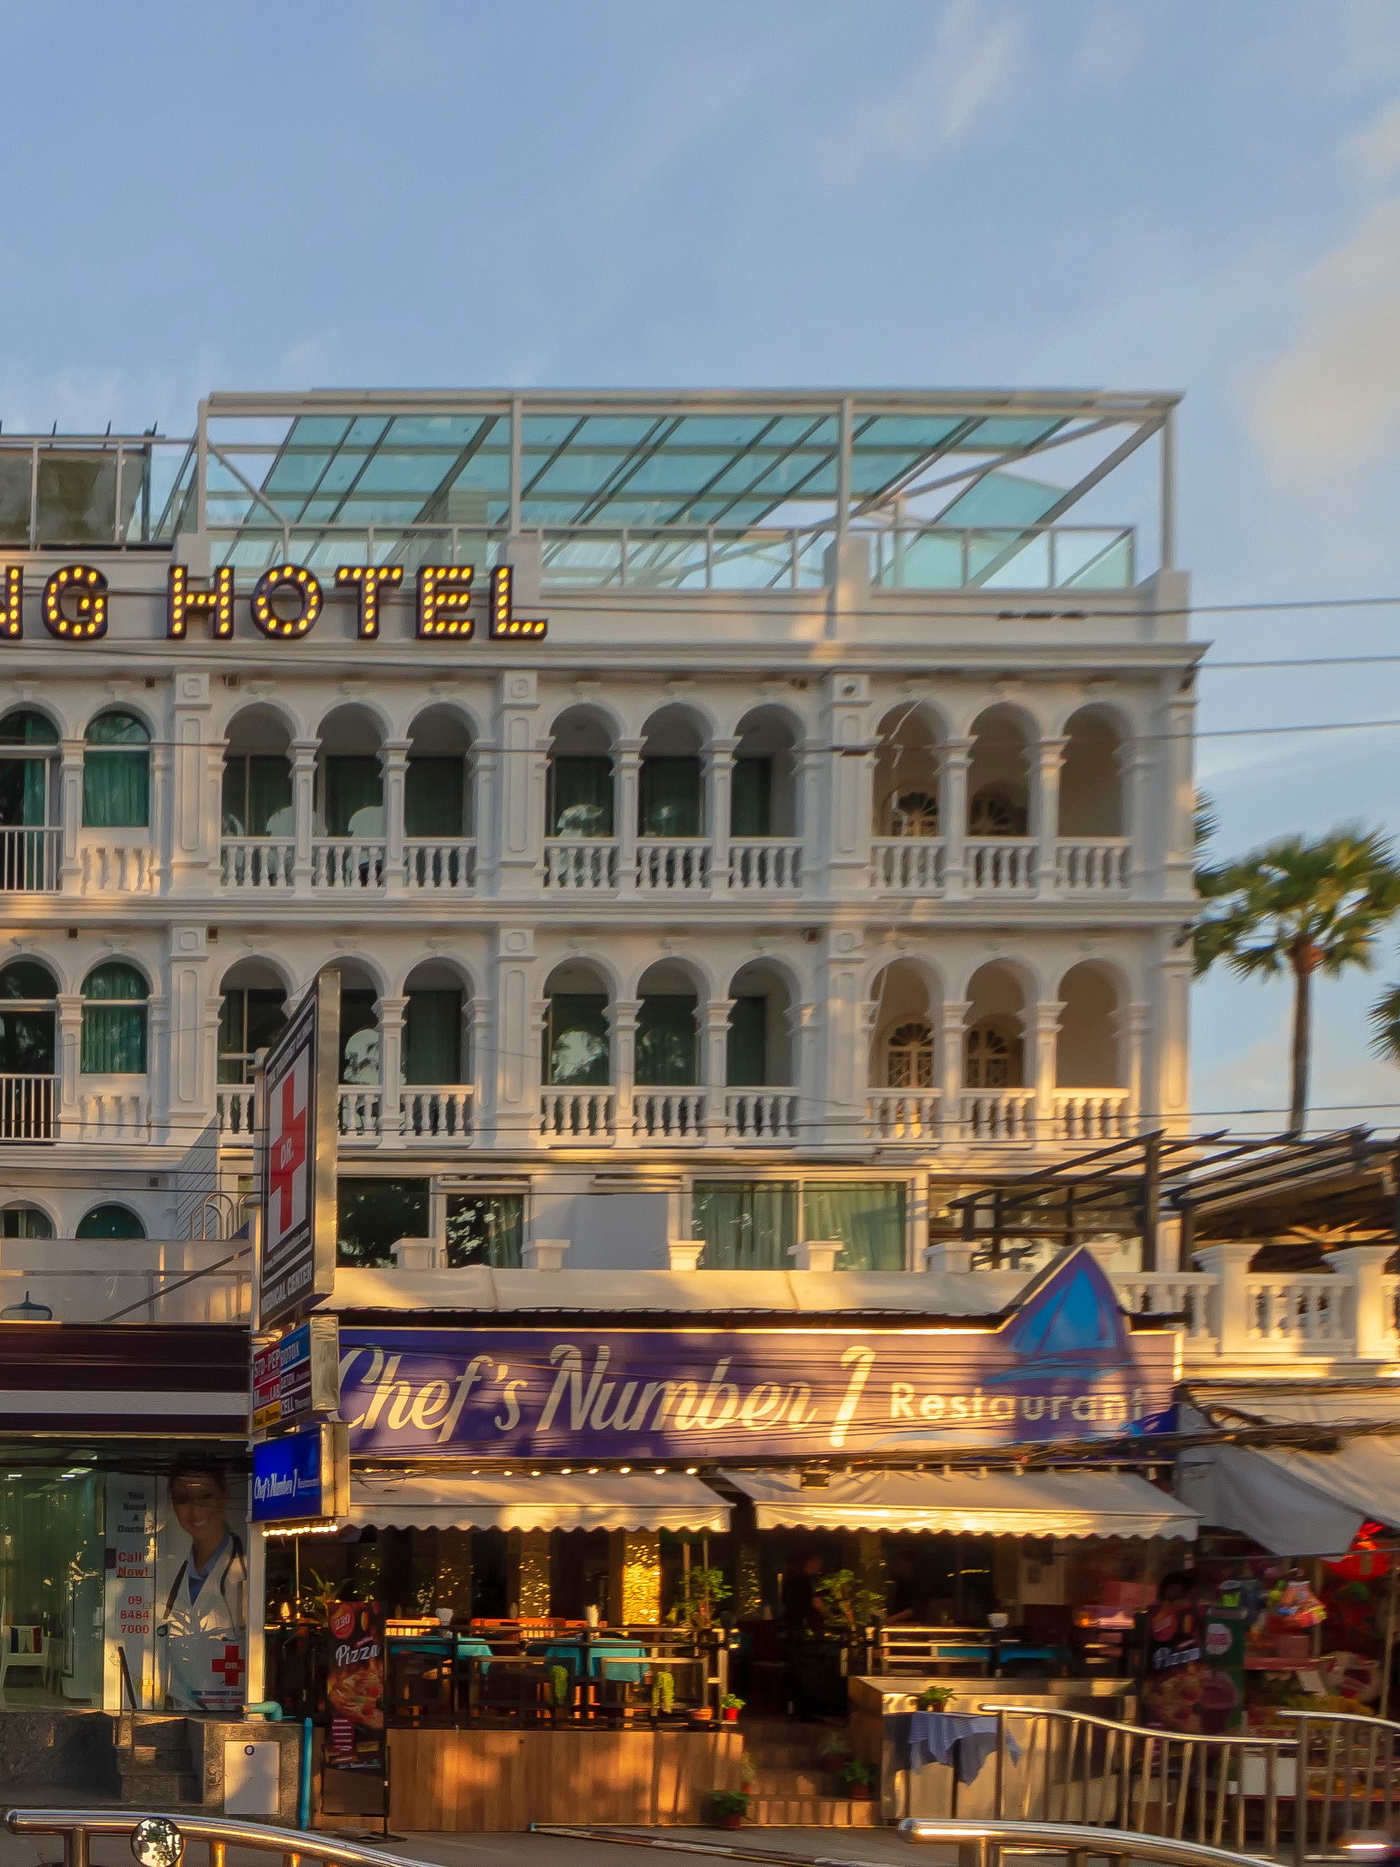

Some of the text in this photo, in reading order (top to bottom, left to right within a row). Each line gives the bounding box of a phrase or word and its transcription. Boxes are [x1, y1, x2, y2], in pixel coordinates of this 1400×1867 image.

[167, 564, 549, 642] HOTEL
[339, 1344, 1144, 1447] Chef's Number 1 Restaurant
[132, 1514, 140, 1523] A
[117, 1551, 143, 1563] Call
[117, 1565, 149, 1578] Now!
[127, 1595, 143, 1606] 09
[120, 1610, 150, 1620] 8484
[120, 1624, 150, 1634] 7000
[335, 1643, 381, 1667] Pizza
